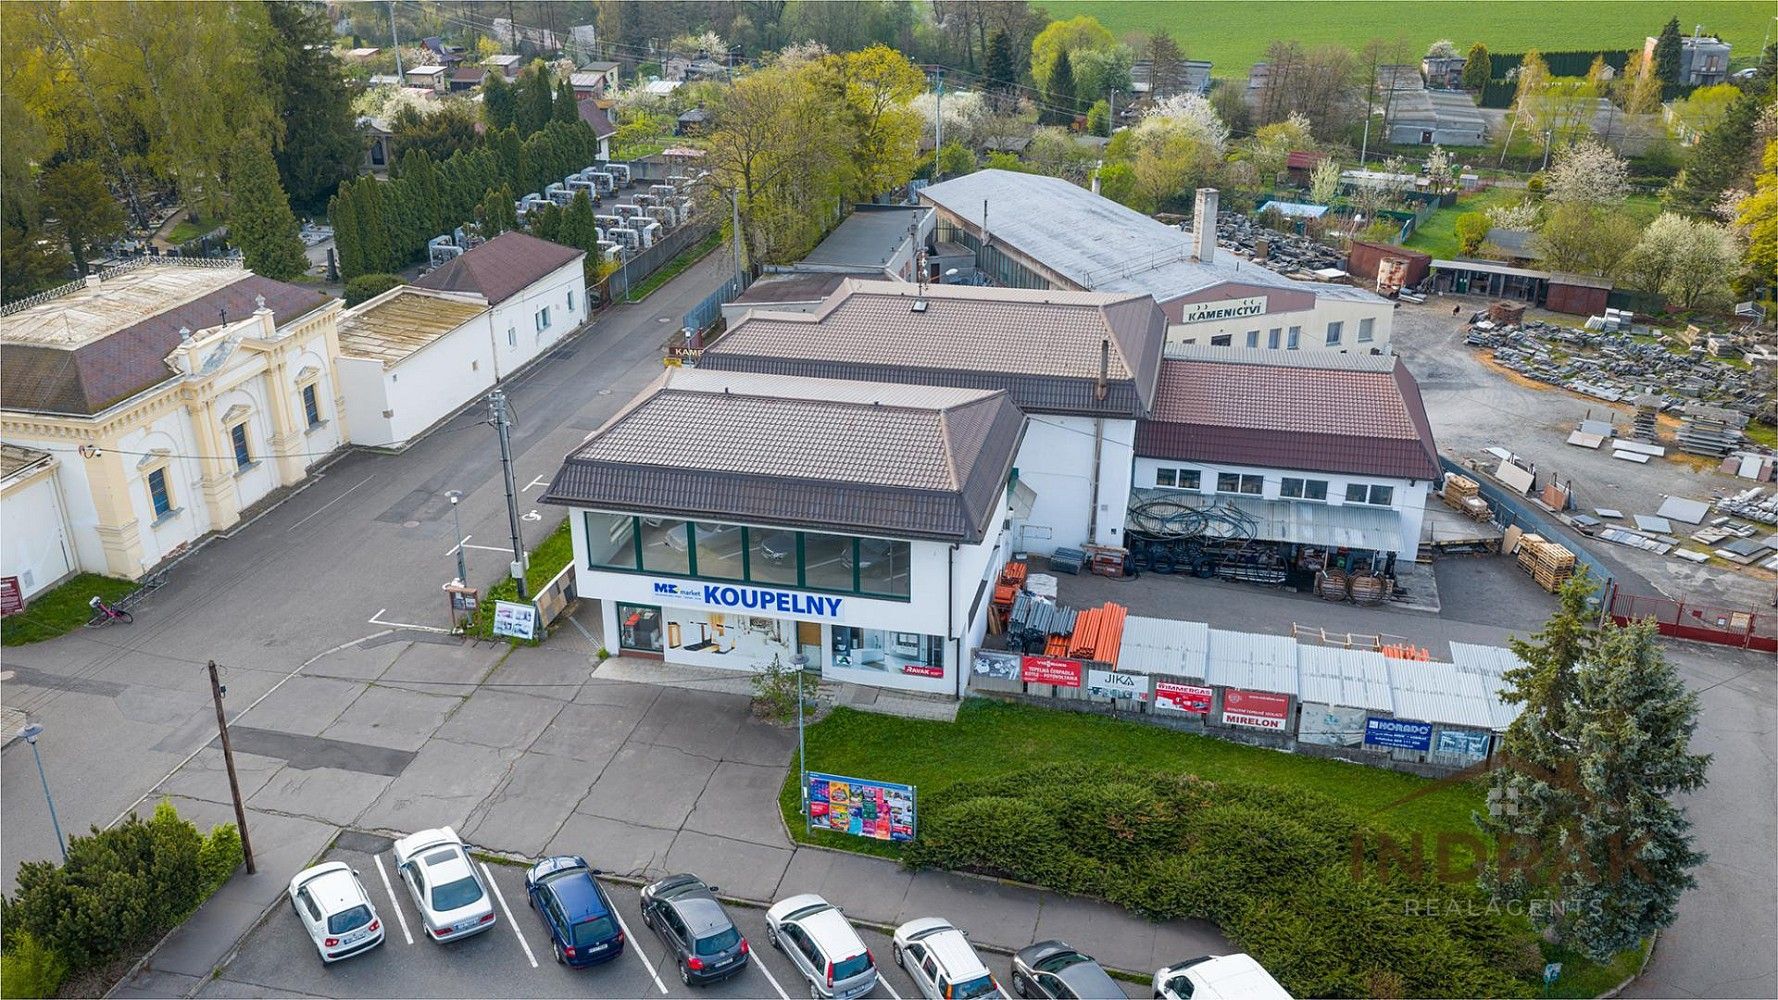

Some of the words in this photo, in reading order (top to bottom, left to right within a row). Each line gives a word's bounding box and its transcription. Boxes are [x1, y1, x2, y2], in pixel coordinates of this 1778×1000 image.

[703, 585, 843, 617] KOUPELNY
[1105, 674, 1134, 686] JIKA
[1226, 715, 1279, 728] MIRELON
